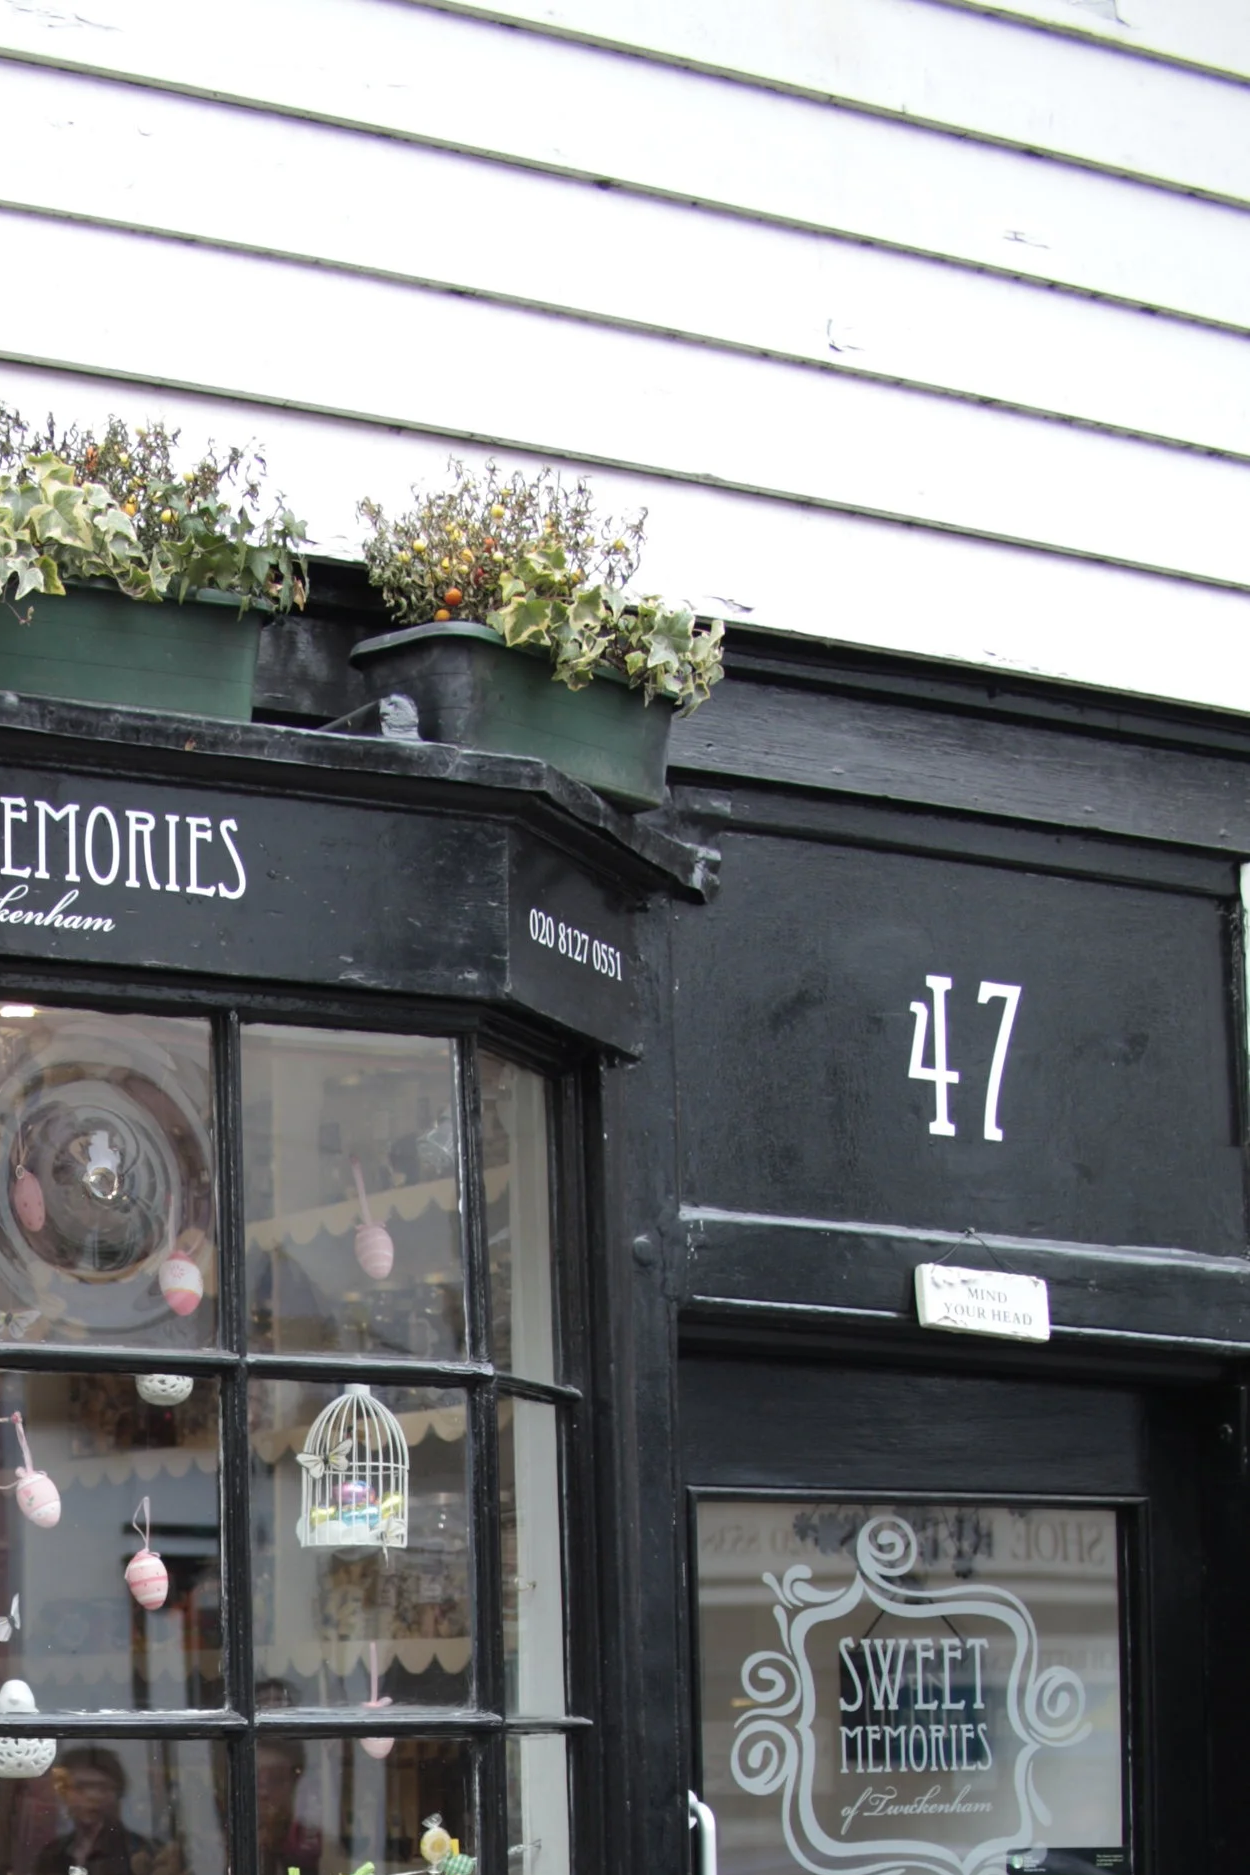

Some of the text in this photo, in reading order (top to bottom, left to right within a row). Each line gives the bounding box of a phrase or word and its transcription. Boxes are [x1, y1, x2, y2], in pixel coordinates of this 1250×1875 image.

[529, 908, 622, 982] 020 8127 0551
[907, 974, 1022, 1142] 47
[944, 1302, 1033, 1326] YOUR HEAD
[967, 1287, 1008, 1304] MIND
[838, 1636, 990, 1712] SWEET
[838, 1723, 993, 1774] MEMORIES
[840, 1784, 993, 1835] of Twickenham
